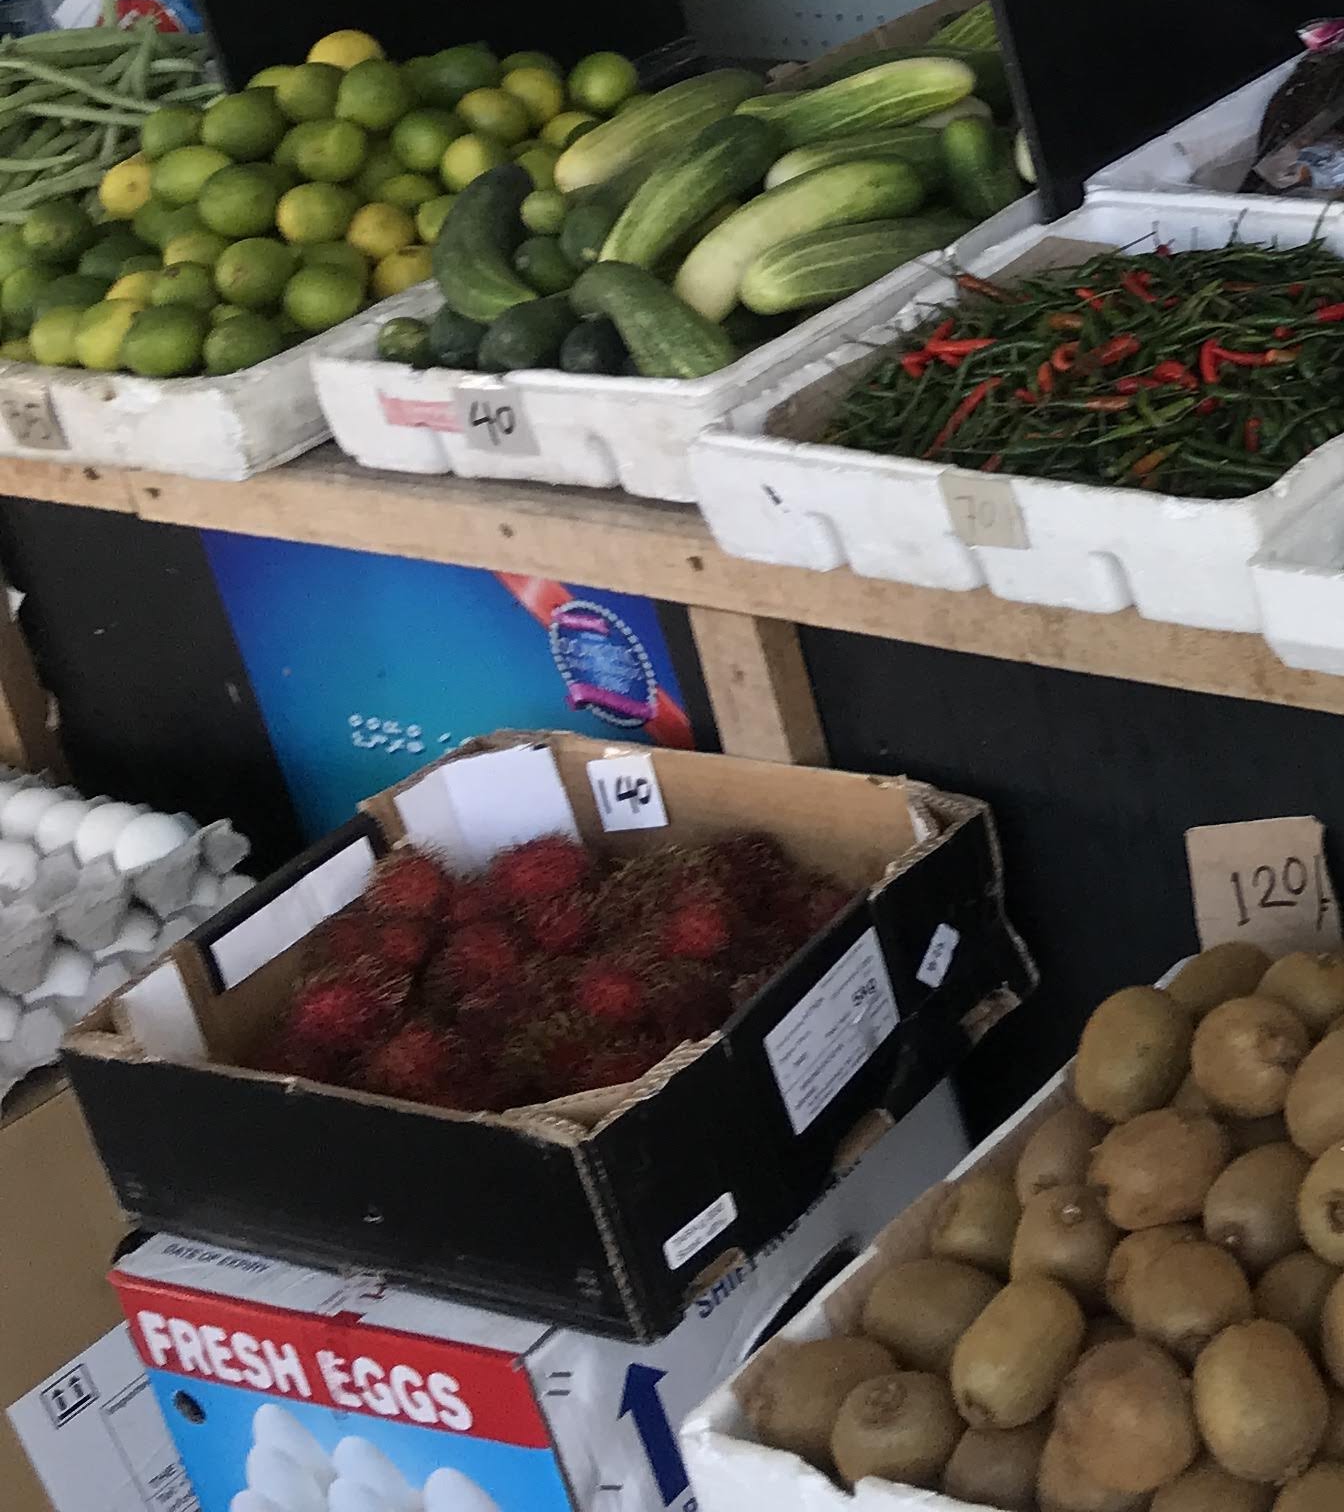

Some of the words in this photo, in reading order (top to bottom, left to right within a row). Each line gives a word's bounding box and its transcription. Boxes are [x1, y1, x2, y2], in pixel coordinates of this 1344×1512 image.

[469, 400, 516, 446] 40
[598, 775, 652, 815] 140
[163, 1243, 198, 1261] DATE
[137, 1309, 312, 1398] FRESH
[315, 1349, 473, 1431] EGGS
